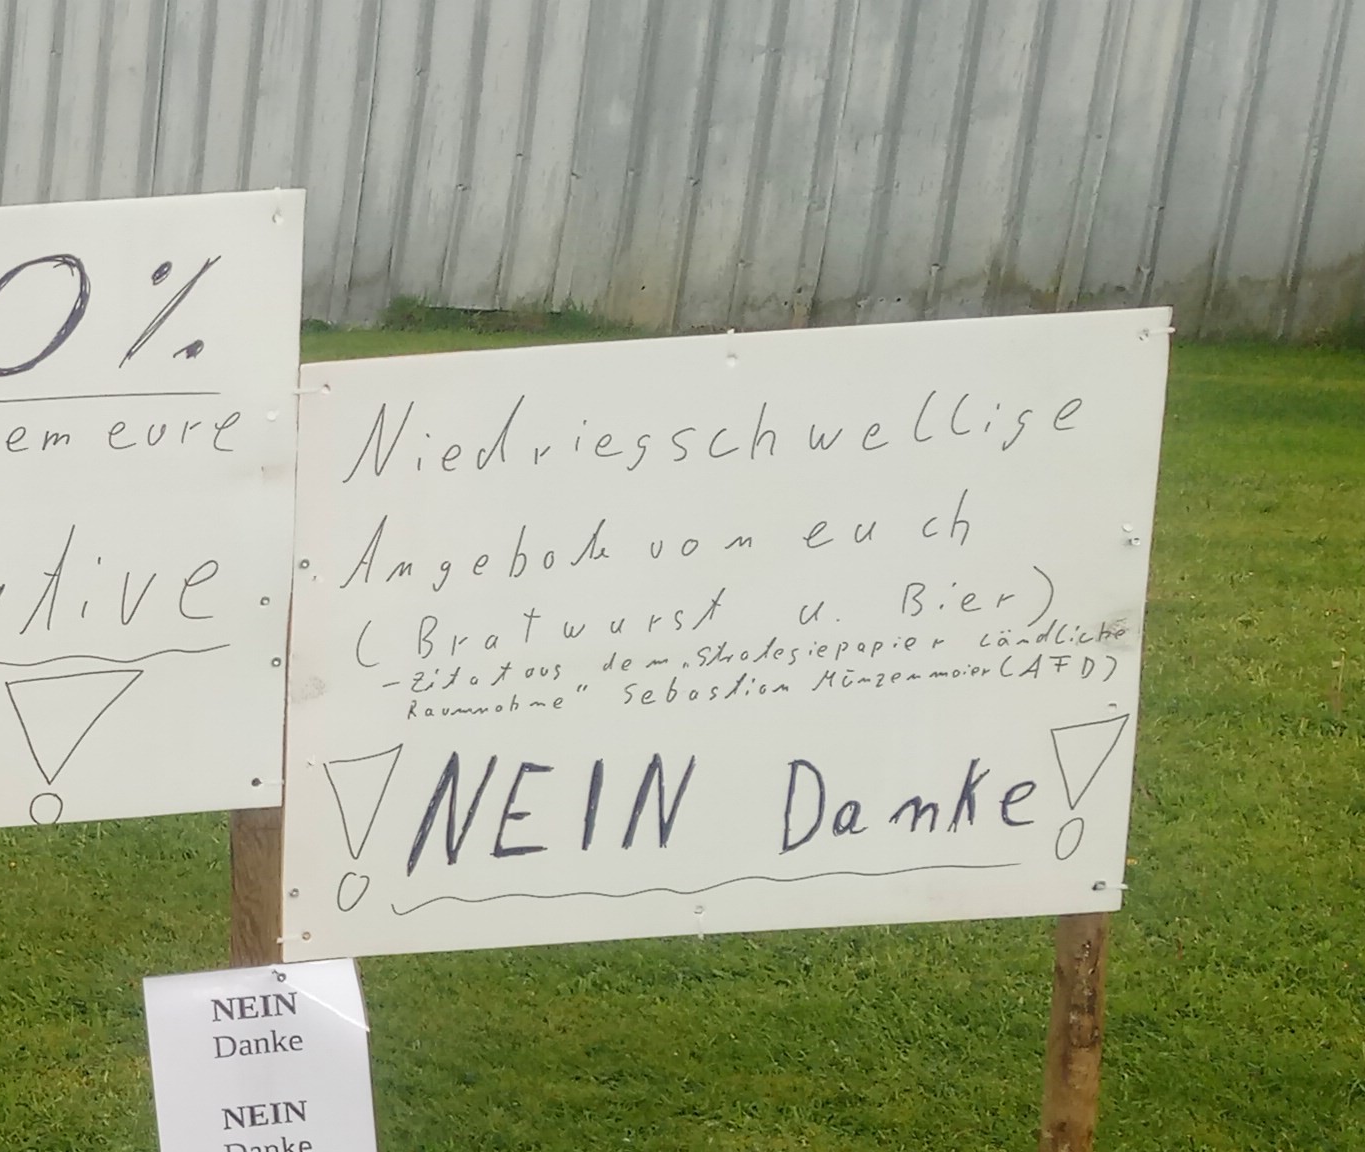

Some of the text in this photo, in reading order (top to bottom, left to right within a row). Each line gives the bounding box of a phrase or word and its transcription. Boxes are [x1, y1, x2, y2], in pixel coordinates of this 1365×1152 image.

[108, 410, 243, 454] eure
[803, 489, 970, 549] euch
[799, 601, 841, 625] u.
[407, 751, 697, 877] NEIN
[779, 757, 1041, 857] Danke
[210, 992, 298, 1023] NEIN
[213, 1030, 304, 1059] Danke
[222, 1100, 307, 1130] NEIN
